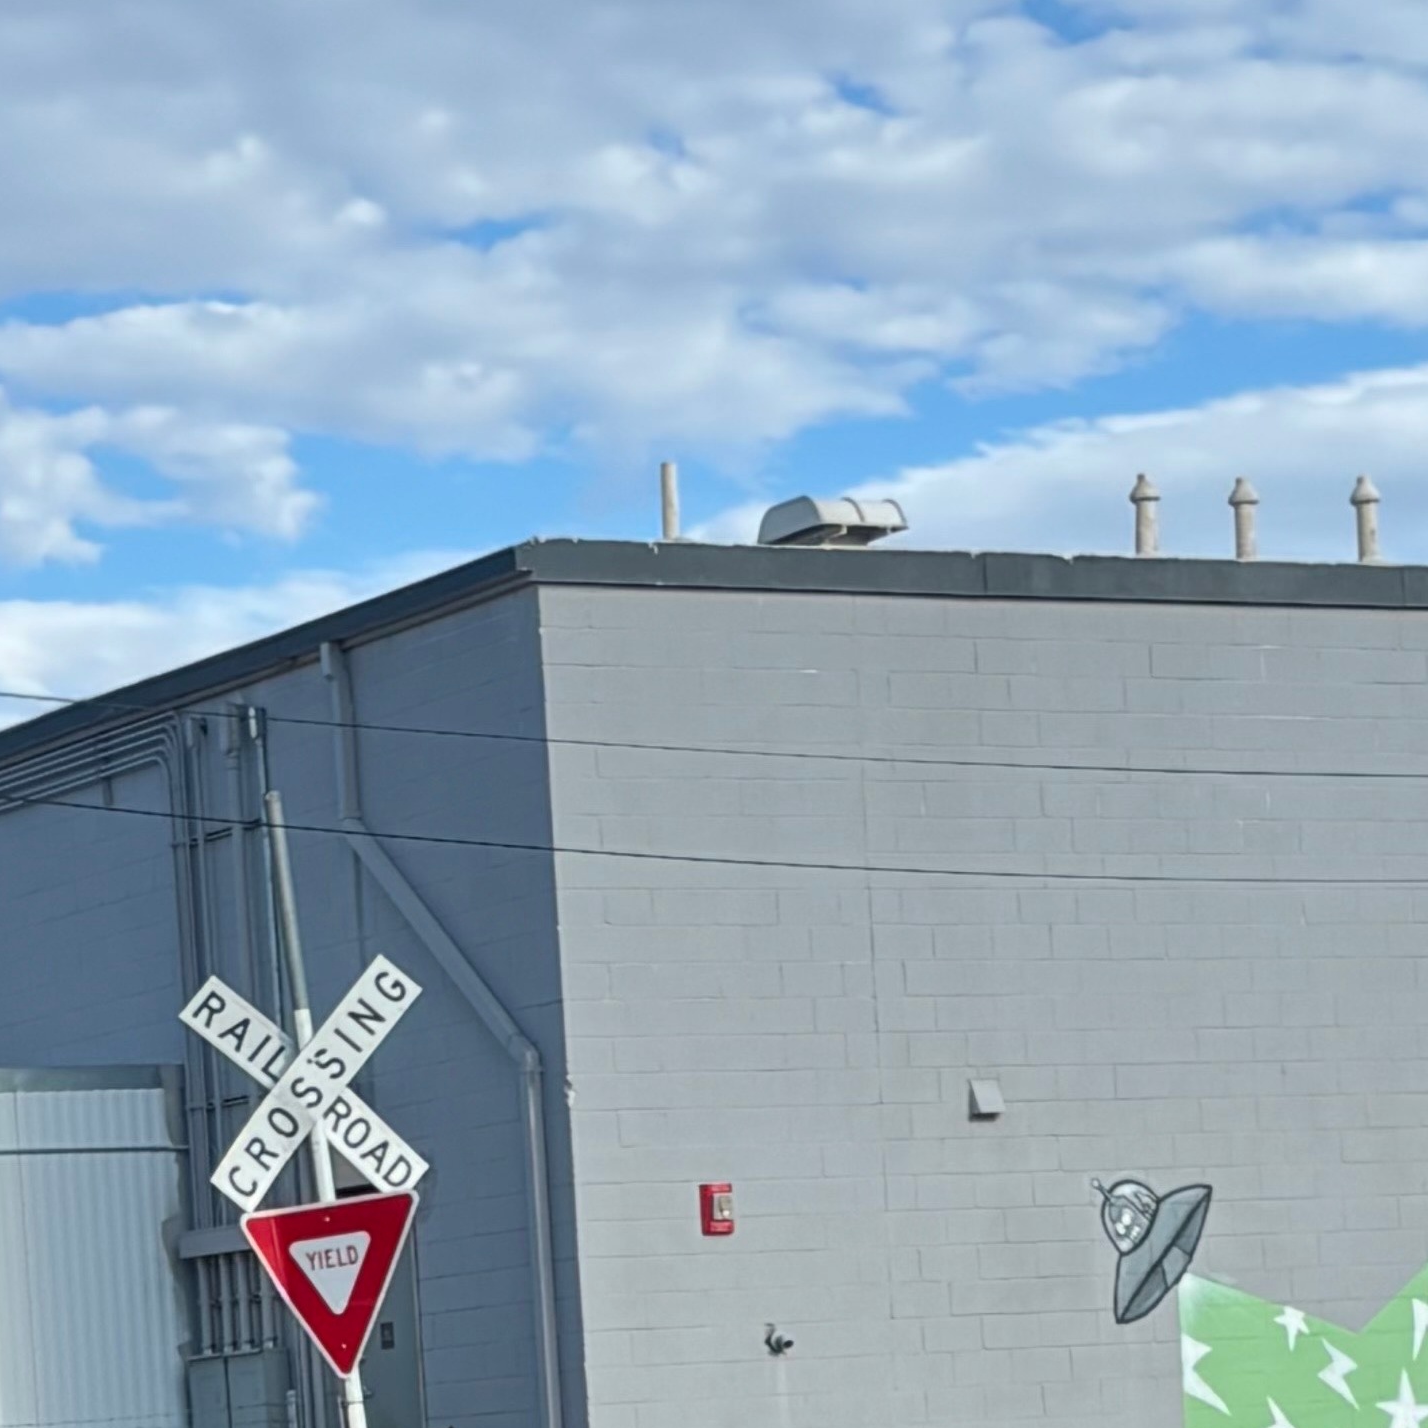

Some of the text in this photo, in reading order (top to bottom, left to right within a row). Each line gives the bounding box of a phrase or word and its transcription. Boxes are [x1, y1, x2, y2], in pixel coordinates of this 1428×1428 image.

[192, 990, 412, 1187] RAIL ROAD
[228, 970, 407, 1197] CROSSING
[304, 1244, 359, 1272] YIELD
